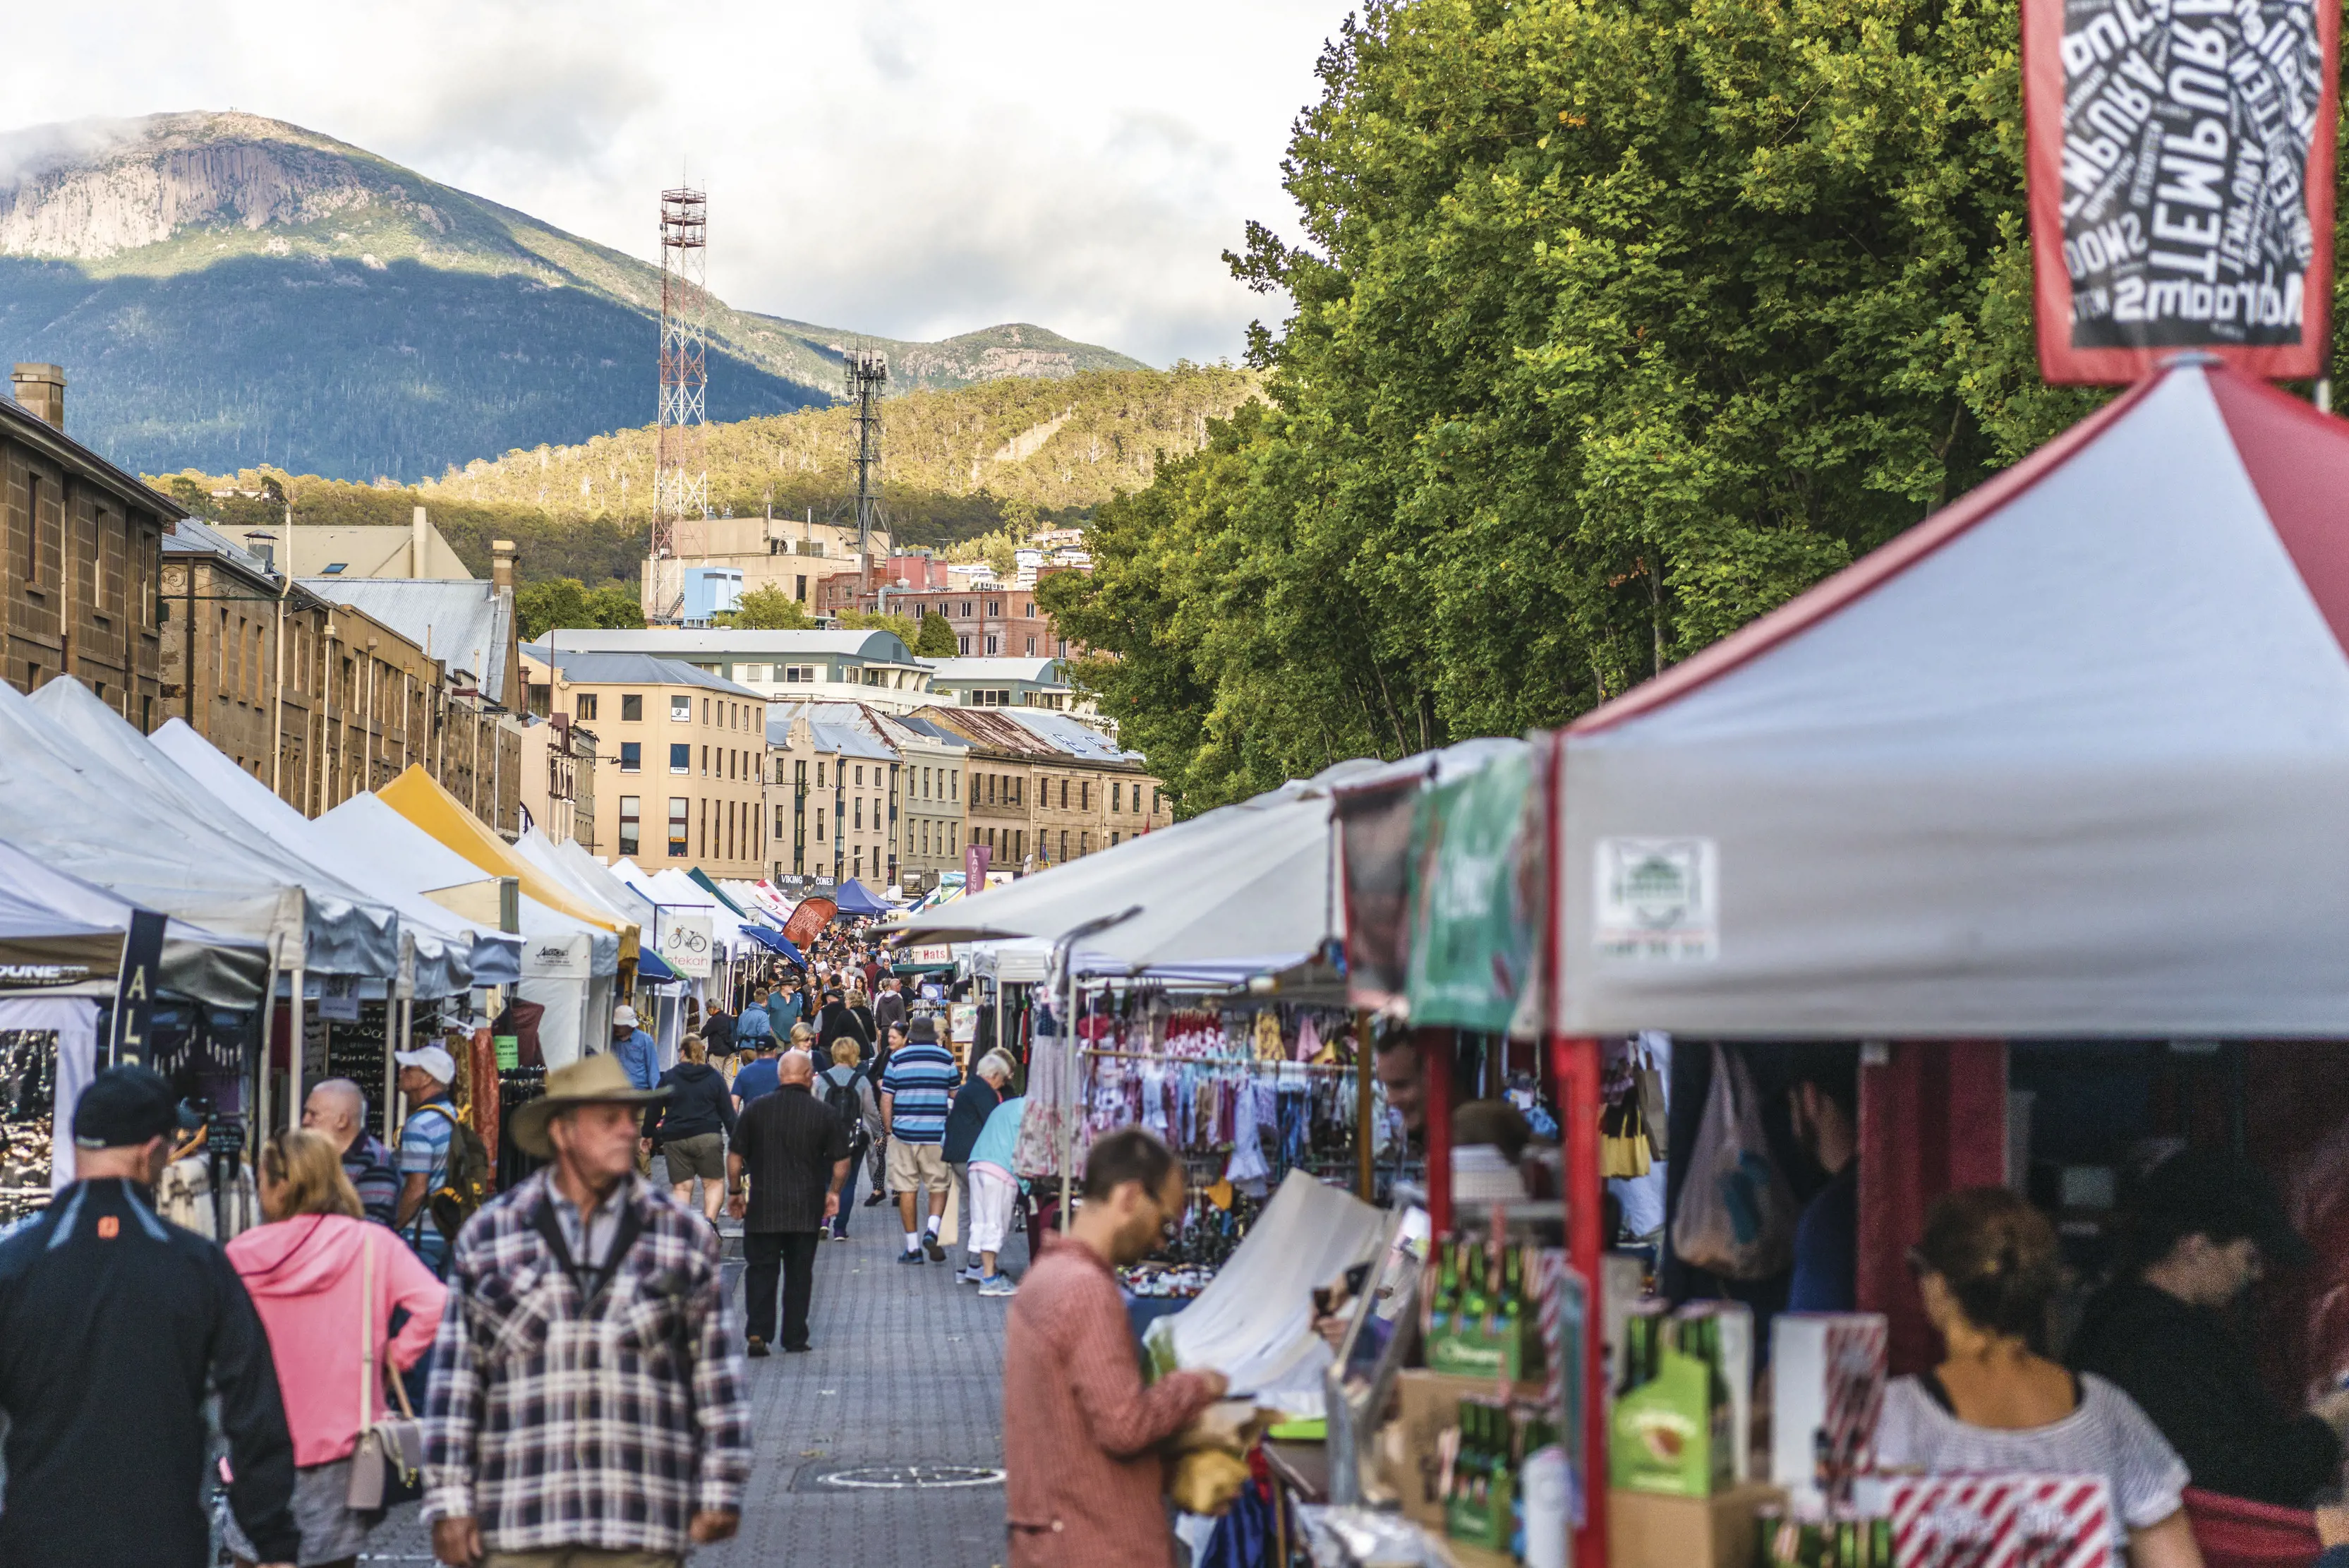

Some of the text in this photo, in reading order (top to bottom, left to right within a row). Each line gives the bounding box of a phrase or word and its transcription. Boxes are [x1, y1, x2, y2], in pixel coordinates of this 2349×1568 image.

[781, 874, 834, 886] VIKING CONES
[799, 905, 822, 925] GOURMET
[787, 920, 803, 935] PIZZA
[924, 949, 946, 960] Hats
